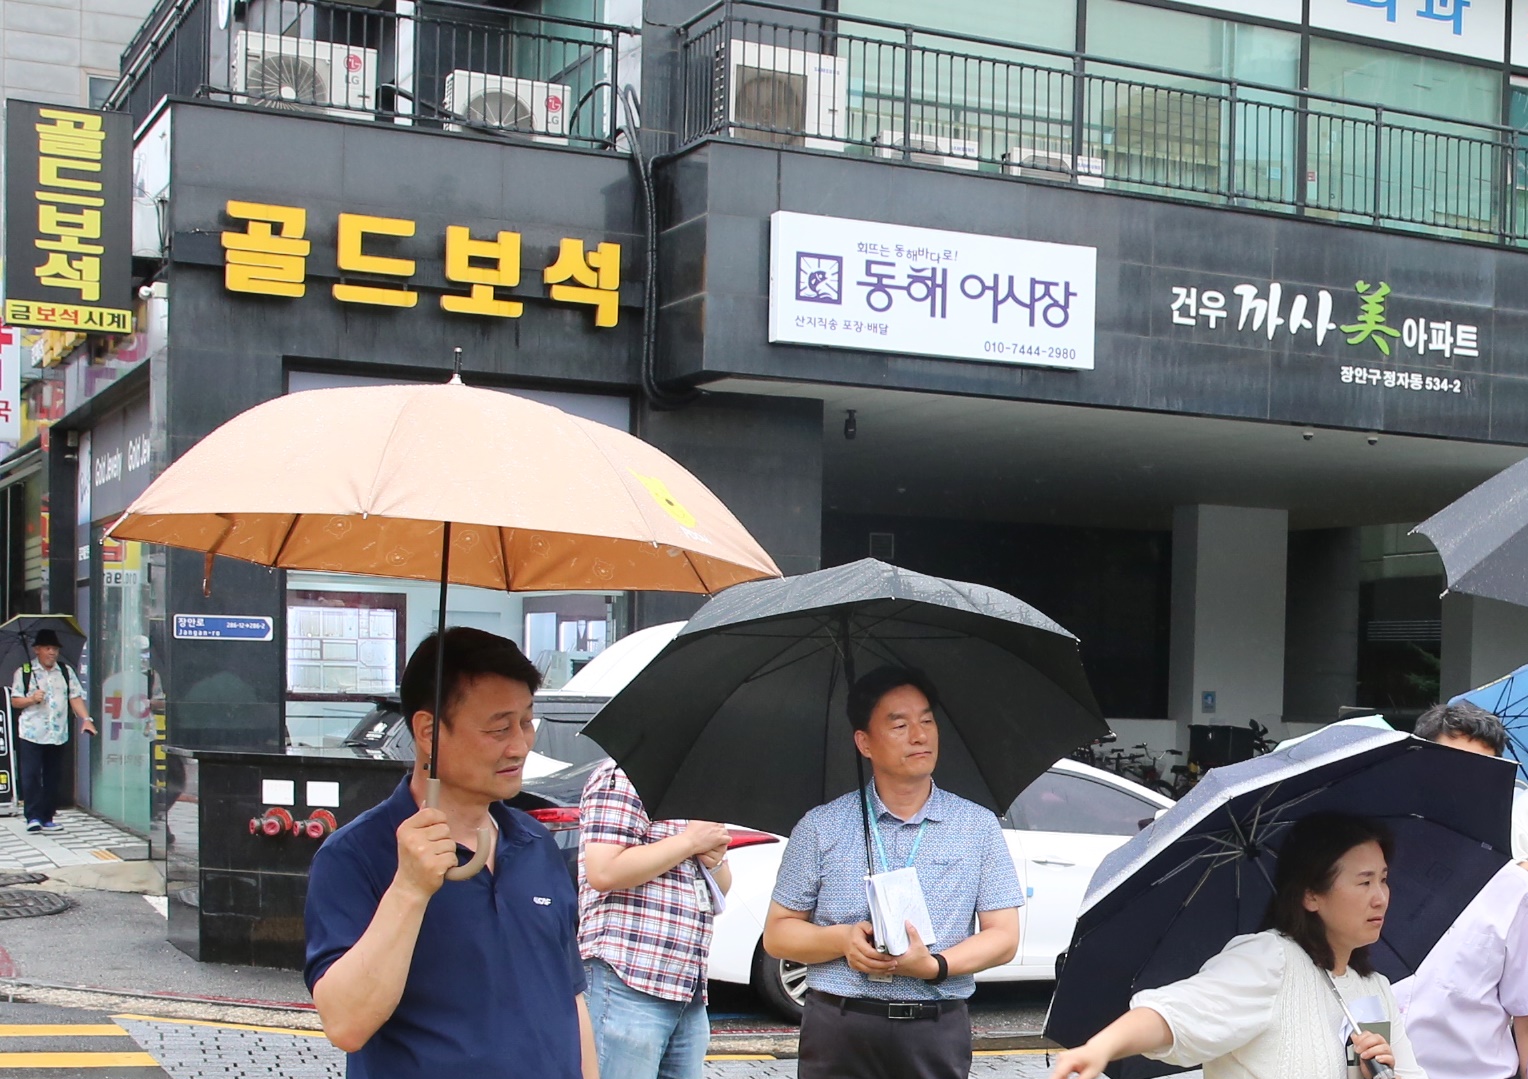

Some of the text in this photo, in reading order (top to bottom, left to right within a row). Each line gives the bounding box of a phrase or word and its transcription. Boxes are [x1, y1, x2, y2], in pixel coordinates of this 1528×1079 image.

[35, 108, 105, 301] 골드보석
[857, 241, 891, 257] 회뜨는
[221, 200, 622, 328] 골드보석
[856, 258, 1078, 329] 동해 어시장
[10, 304, 126, 329] 금 보석 시계
[794, 315, 838, 331] 산지직송
[1170, 286, 1227, 329] 건우
[1402, 317, 1479, 358] 아파트
[983, 340, 1077, 360] 010-7444-2980
[1340, 365, 1462, 394] 장안구 정자동 534-2
[178, 617, 205, 628] 장안로
